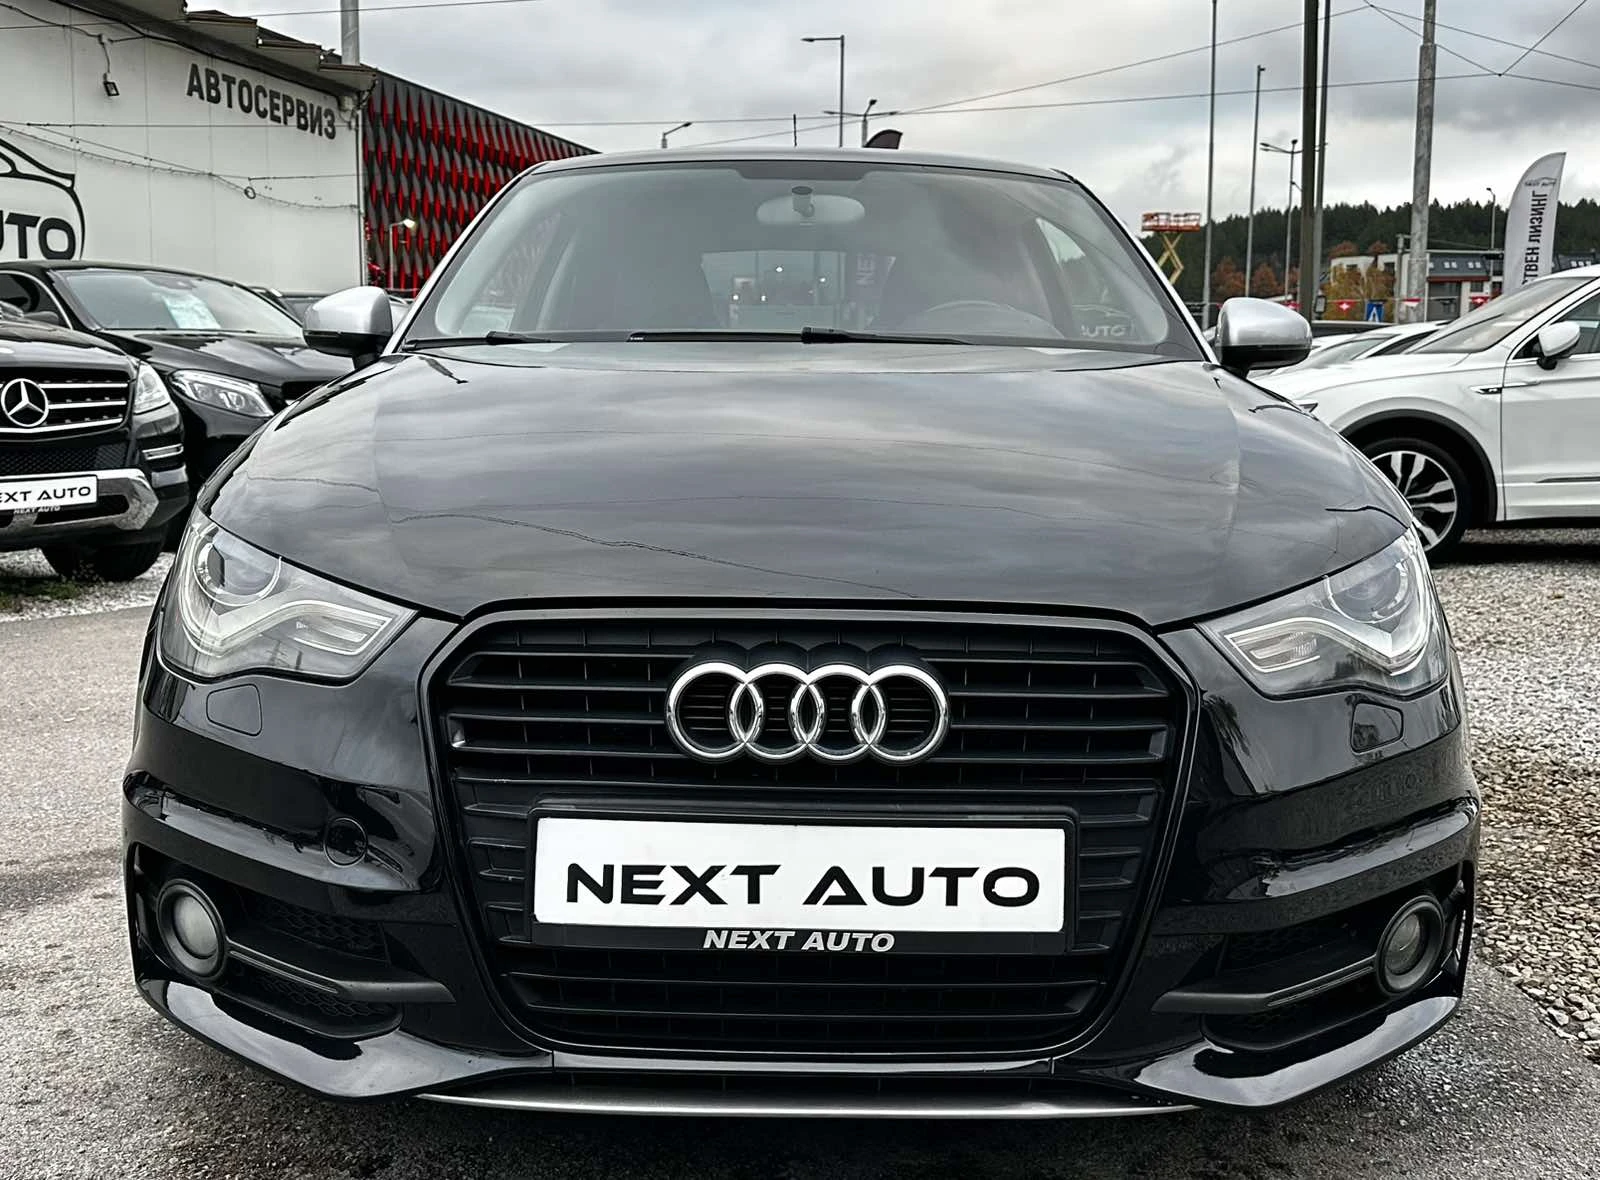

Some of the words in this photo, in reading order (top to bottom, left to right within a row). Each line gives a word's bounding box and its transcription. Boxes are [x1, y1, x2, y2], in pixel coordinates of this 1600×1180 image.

[186, 62, 336, 140] АВТОСЕРВИЗ
[0, 209, 76, 260] TO
[1527, 190, 1548, 243] ЛИЗИНГ
[0, 490, 32, 503] XT
[37, 486, 91, 501] AUTO
[566, 862, 782, 906] NEXT
[802, 865, 1040, 908] AUTO
[703, 929, 796, 950] NEXT
[801, 931, 896, 952] AUTO
